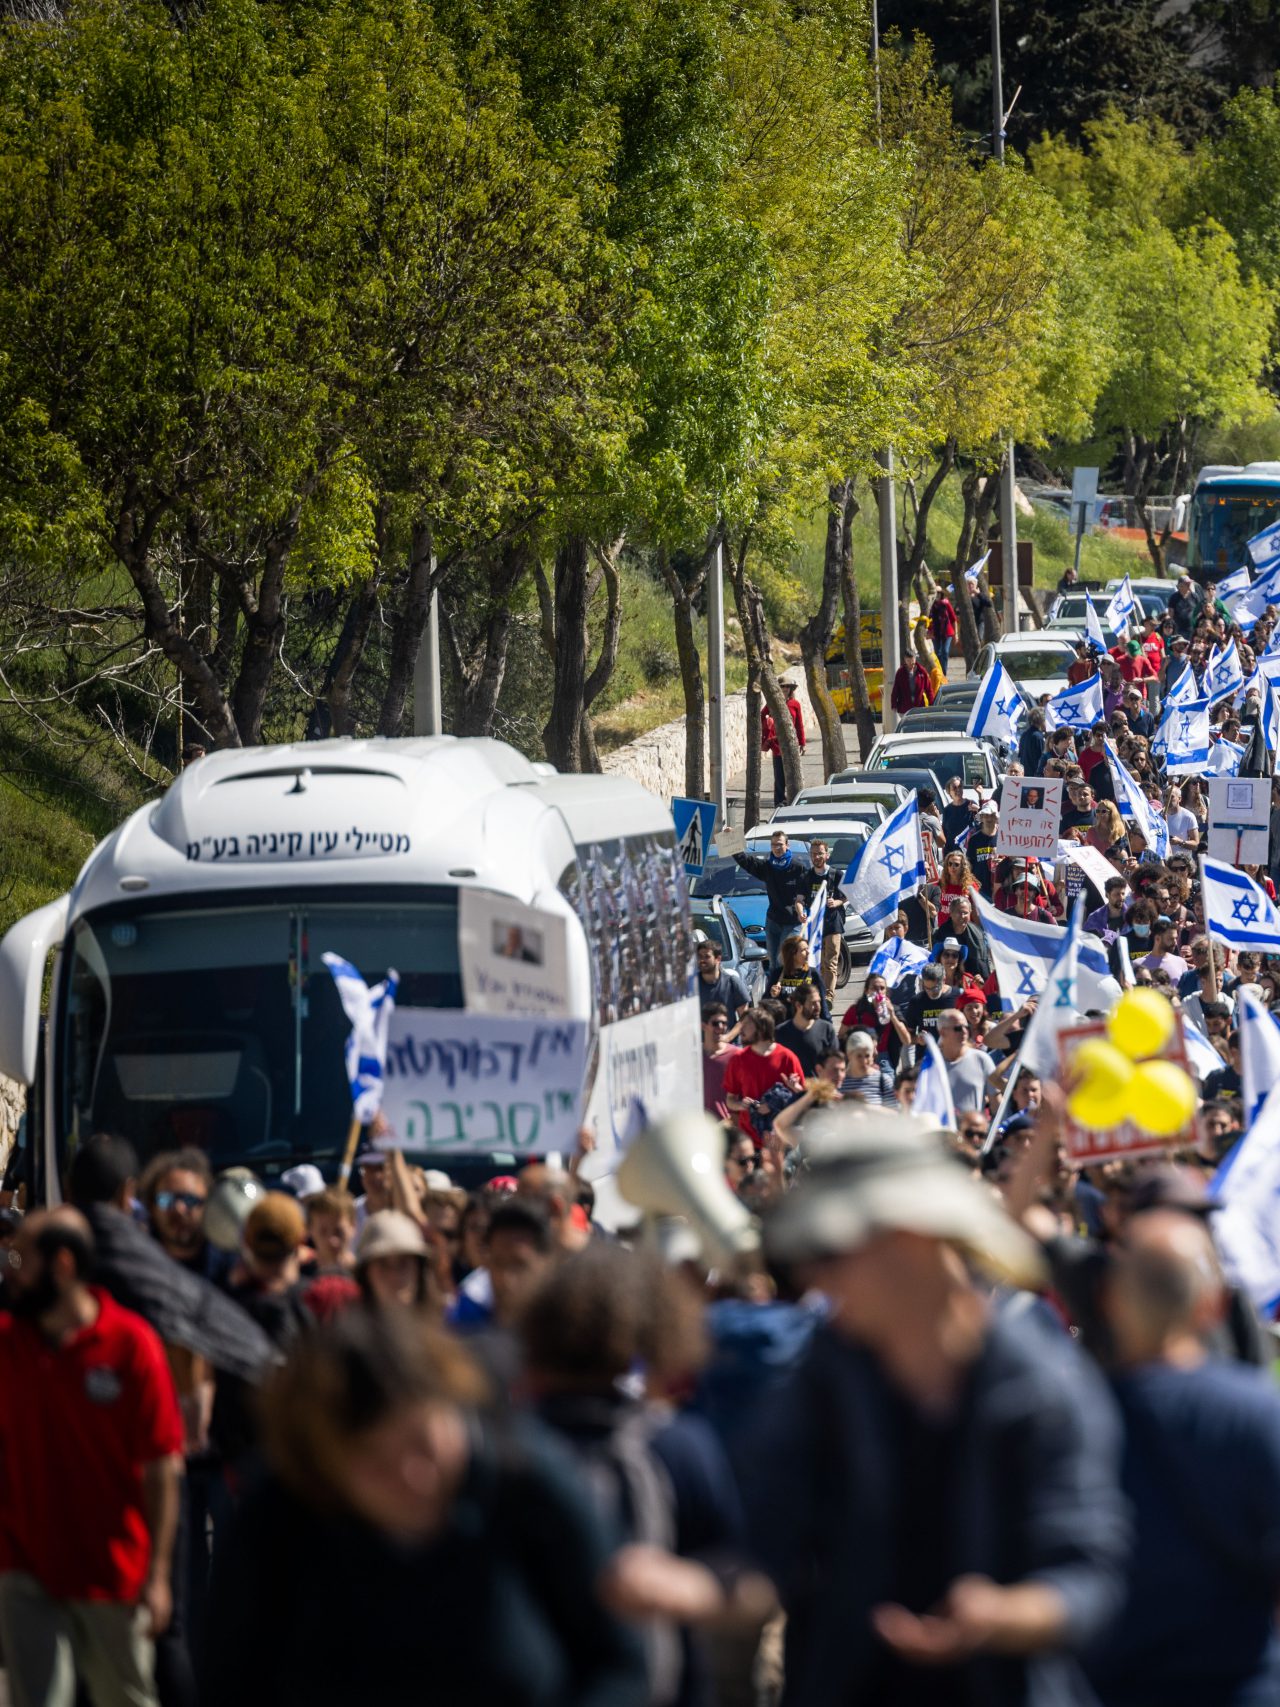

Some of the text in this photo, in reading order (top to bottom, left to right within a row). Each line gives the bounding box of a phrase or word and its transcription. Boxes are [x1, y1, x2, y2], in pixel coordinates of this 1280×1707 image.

[246, 831, 303, 857] קיניה
[309, 831, 338, 856] עין
[345, 826, 411, 853] מטיילי
[1001, 830, 1054, 849] להתעורר!
[406, 1099, 541, 1148] סביבה
